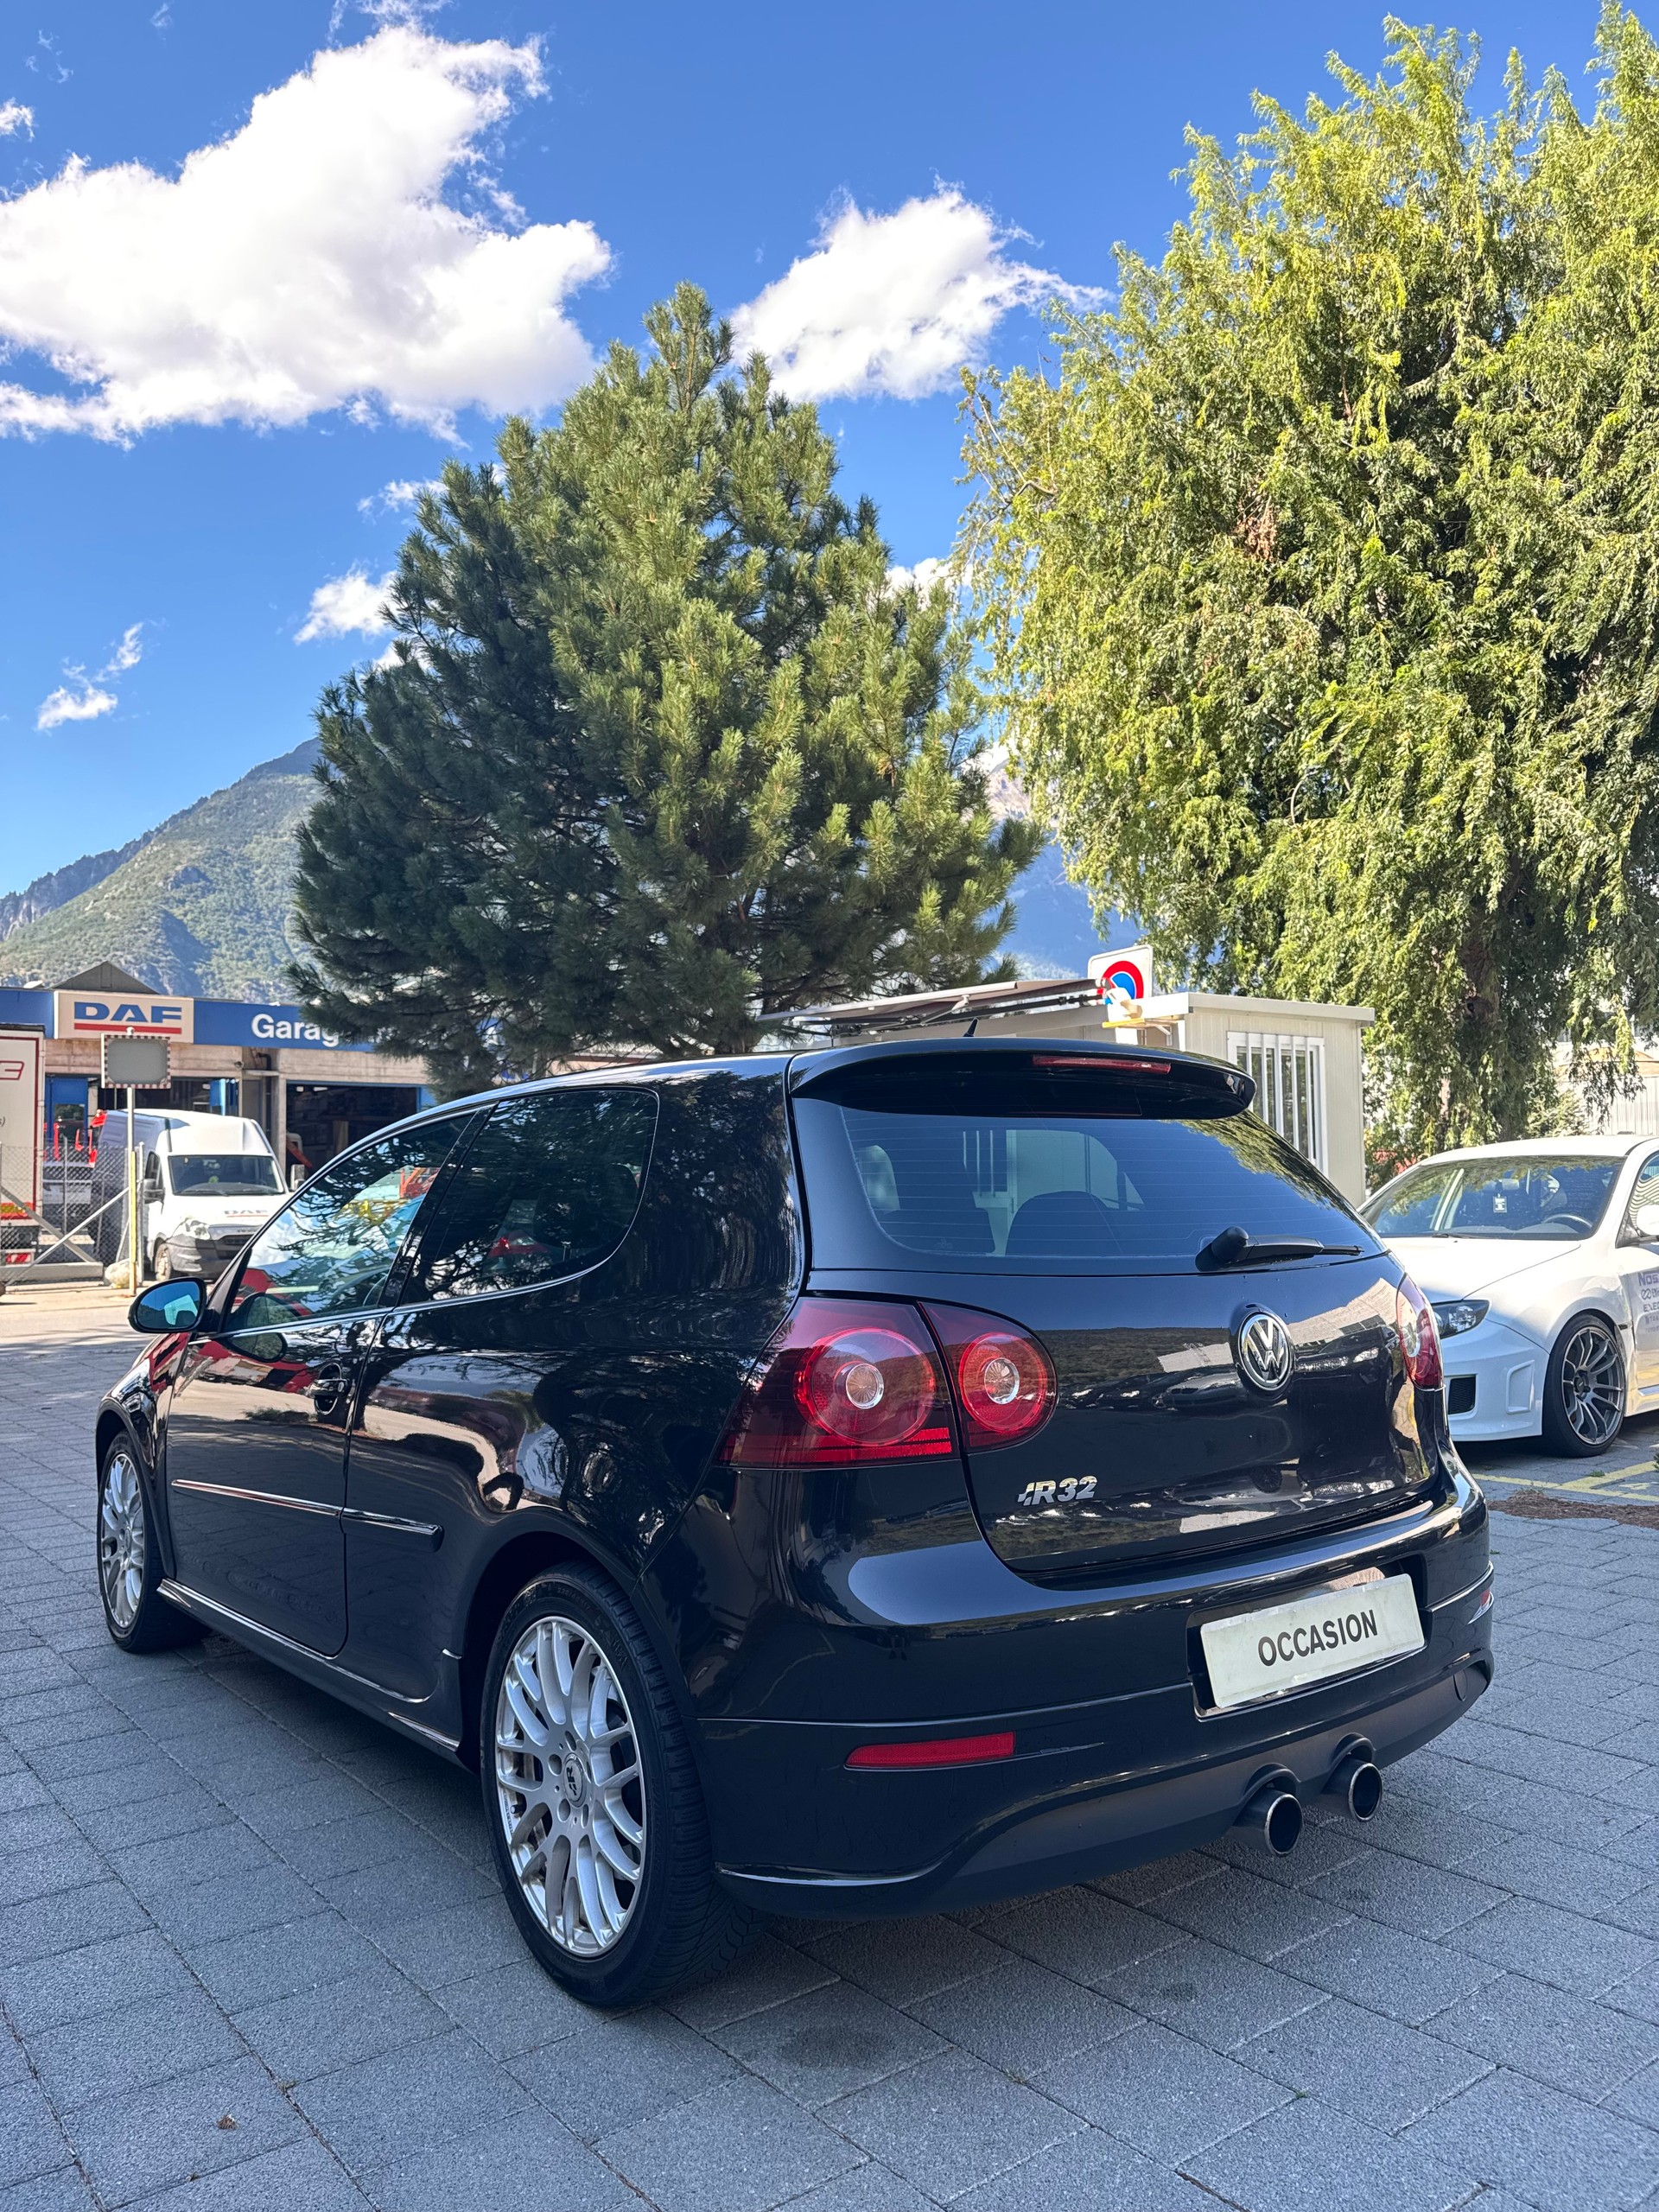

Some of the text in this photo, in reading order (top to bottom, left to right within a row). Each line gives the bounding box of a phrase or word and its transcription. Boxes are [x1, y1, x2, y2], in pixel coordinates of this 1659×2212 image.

[74, 1001, 182, 1023] DAF
[251, 1014, 351, 1048] Garag
[1241, 1313, 1290, 1389] VW
[1018, 1475, 1097, 1506] R32
[1258, 1609, 1378, 1667] OCCASION
